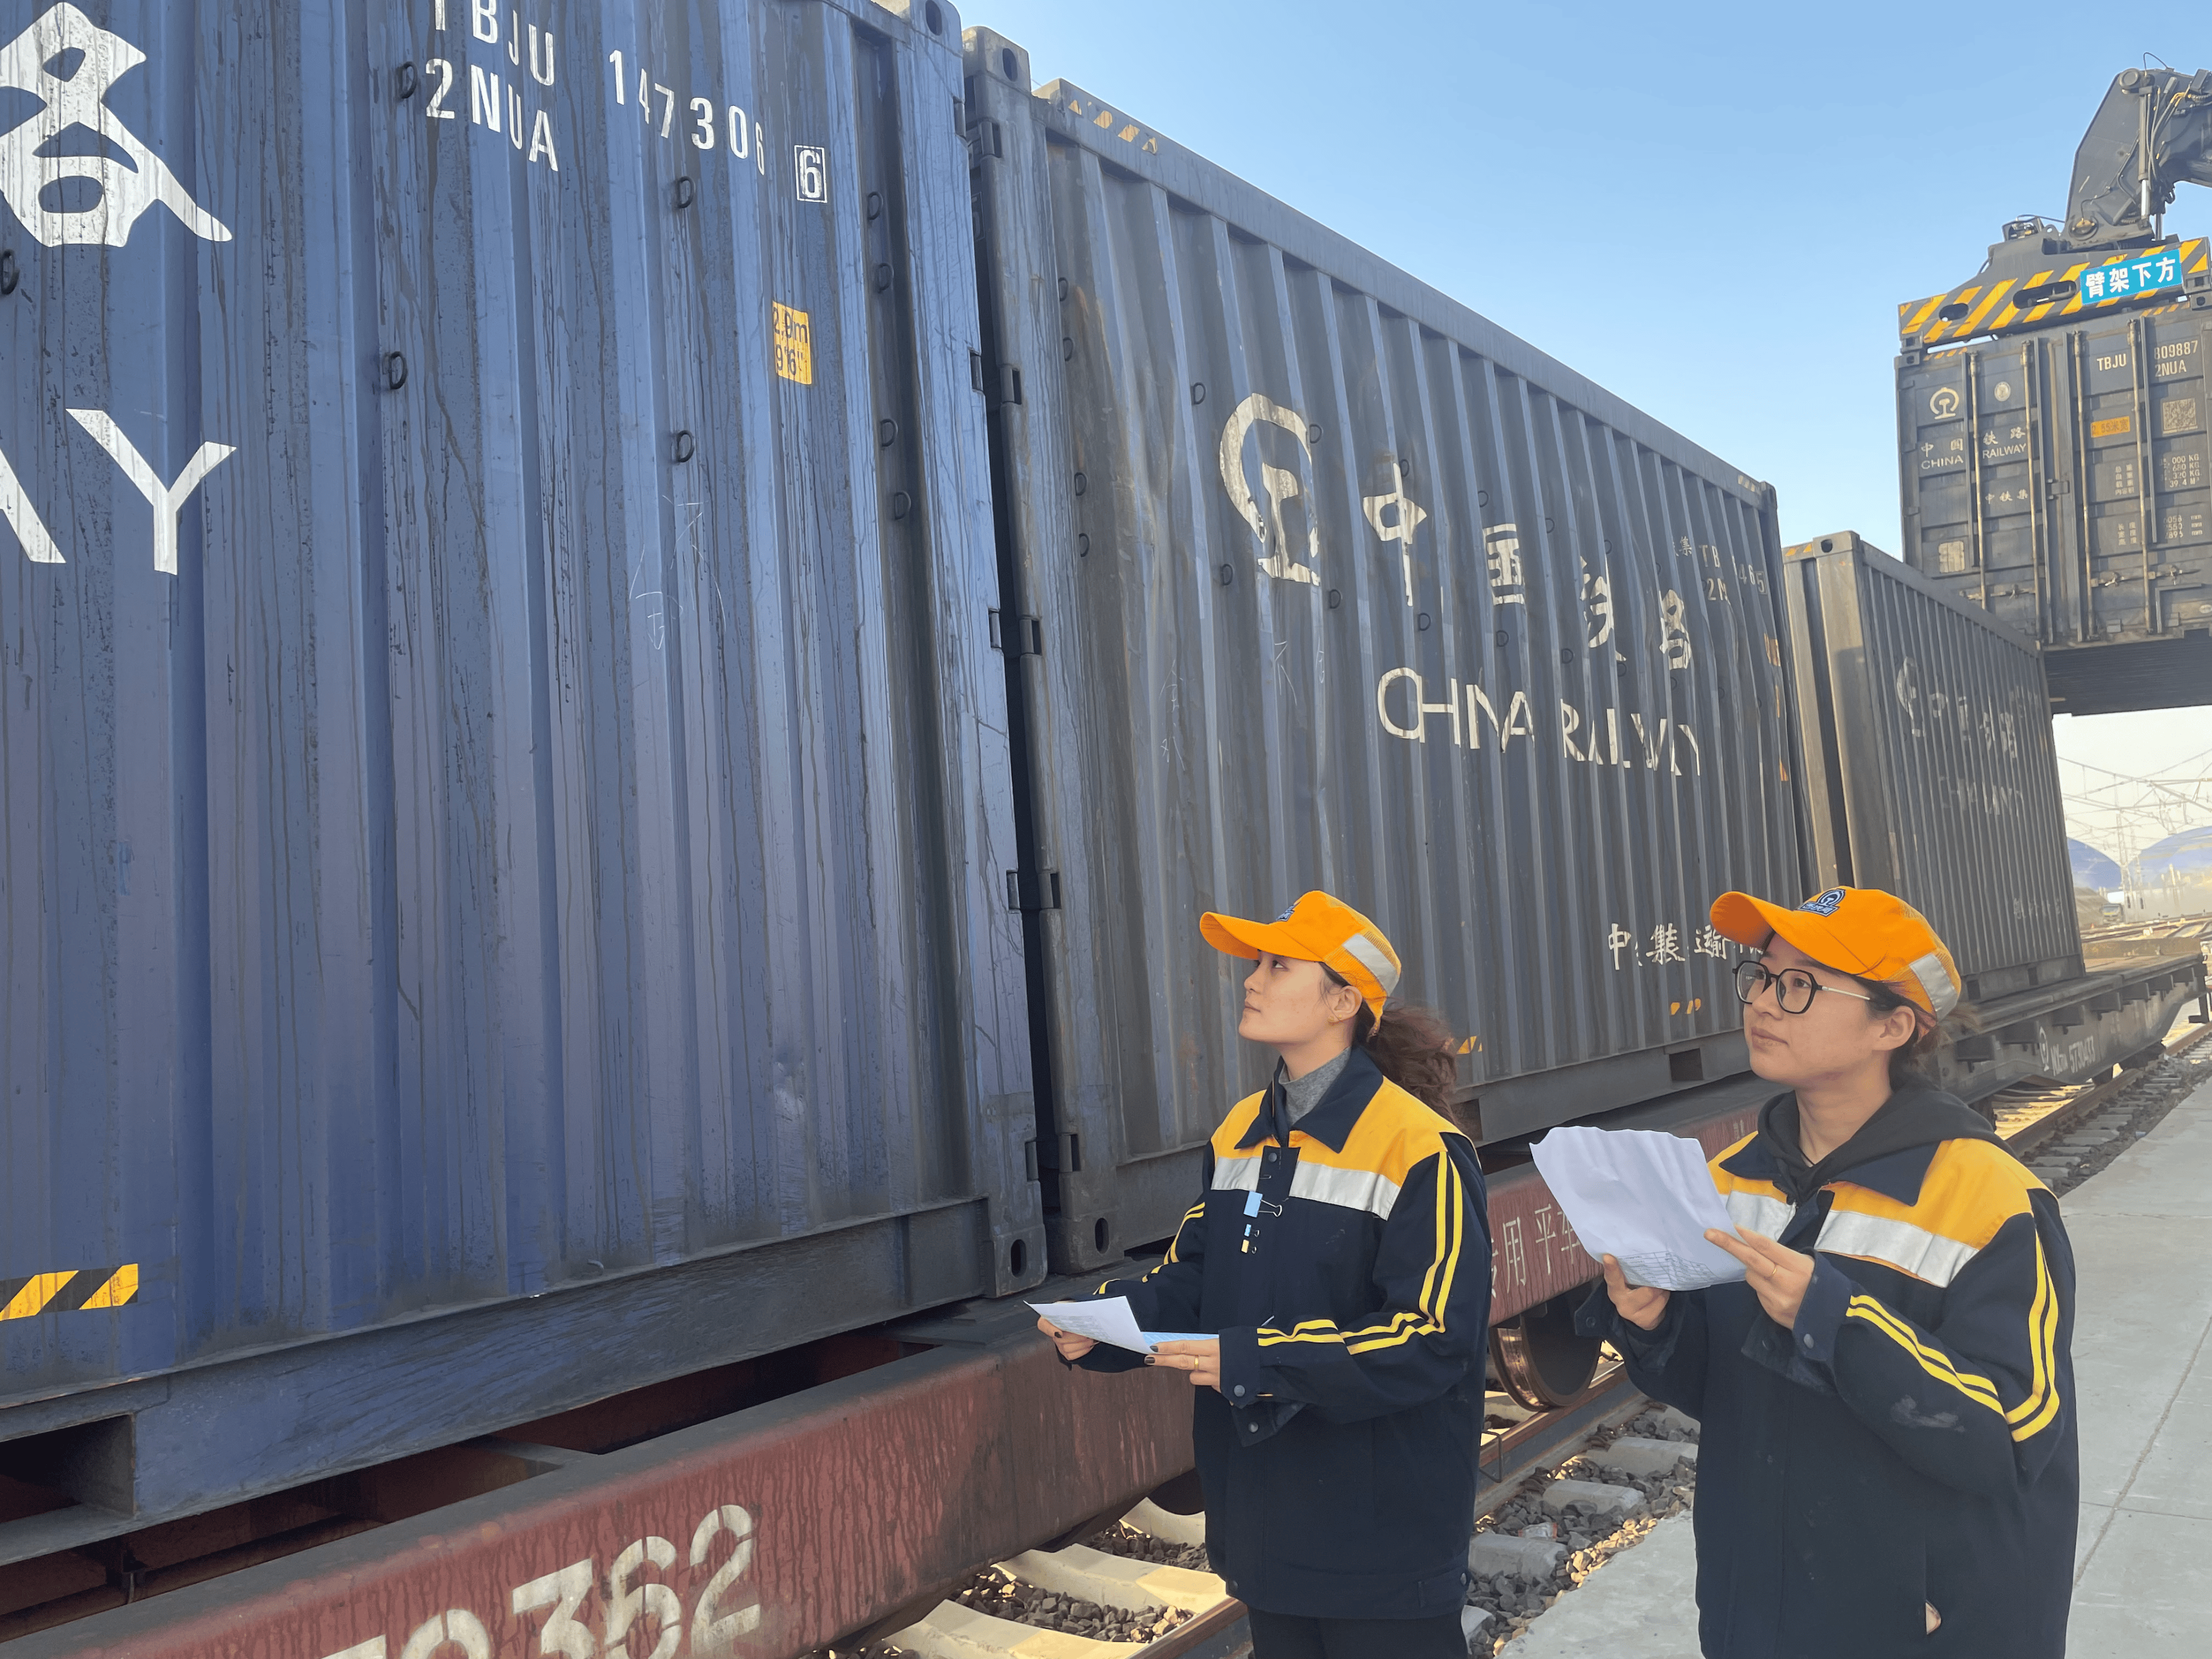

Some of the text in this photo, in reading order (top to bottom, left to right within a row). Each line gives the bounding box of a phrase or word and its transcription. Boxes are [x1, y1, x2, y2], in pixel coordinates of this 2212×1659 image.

[425, 58, 558, 172] 2NUA
[609, 50, 764, 176] 147306
[799, 149, 822, 199] 6
[2085, 257, 2176, 298] 臂架下方
[2097, 340, 2198, 372] TBJU 809887
[2155, 359, 2187, 377] 2NUA
[1921, 443, 2026, 470] CHINA RAILWAY
